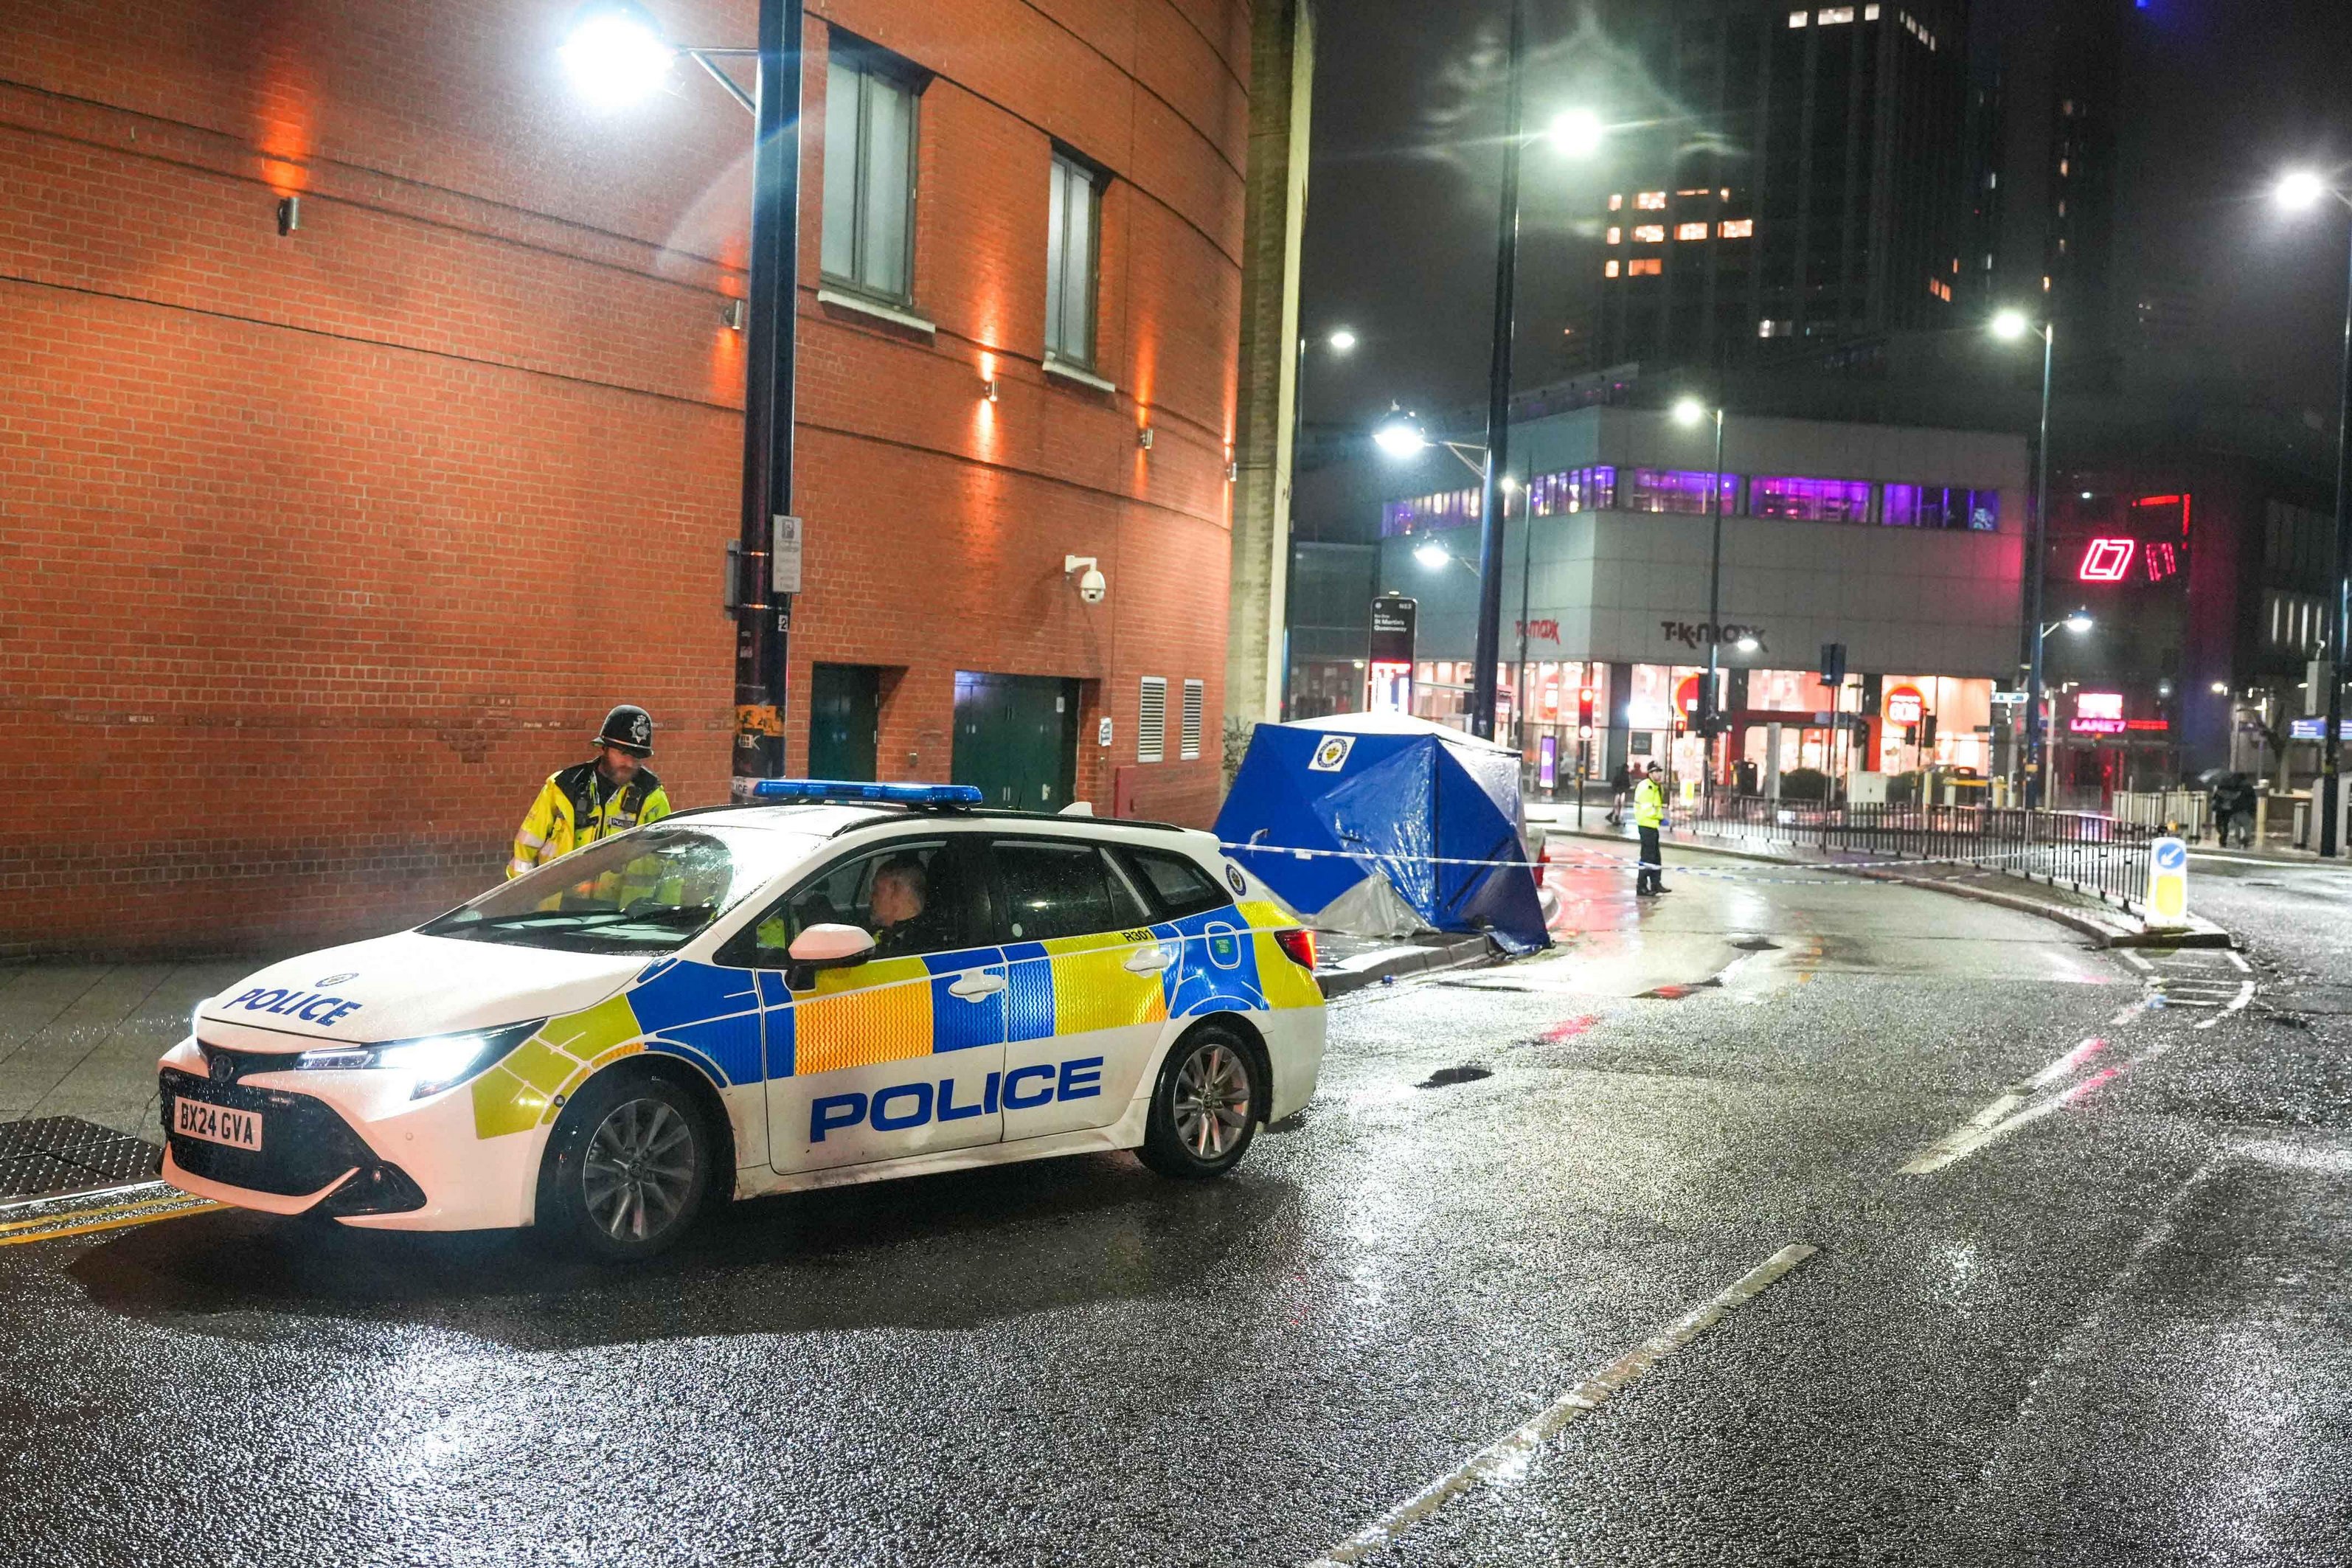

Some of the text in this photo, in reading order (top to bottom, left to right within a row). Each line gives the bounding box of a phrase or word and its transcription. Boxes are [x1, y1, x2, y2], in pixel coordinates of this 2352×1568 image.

[781, 618, 787, 629] 2
[1123, 929, 1154, 942] R301
[221, 988, 363, 1027] POLICE
[810, 1056, 1103, 1143] POLICE
[180, 1102, 254, 1145] BX24 GVA
